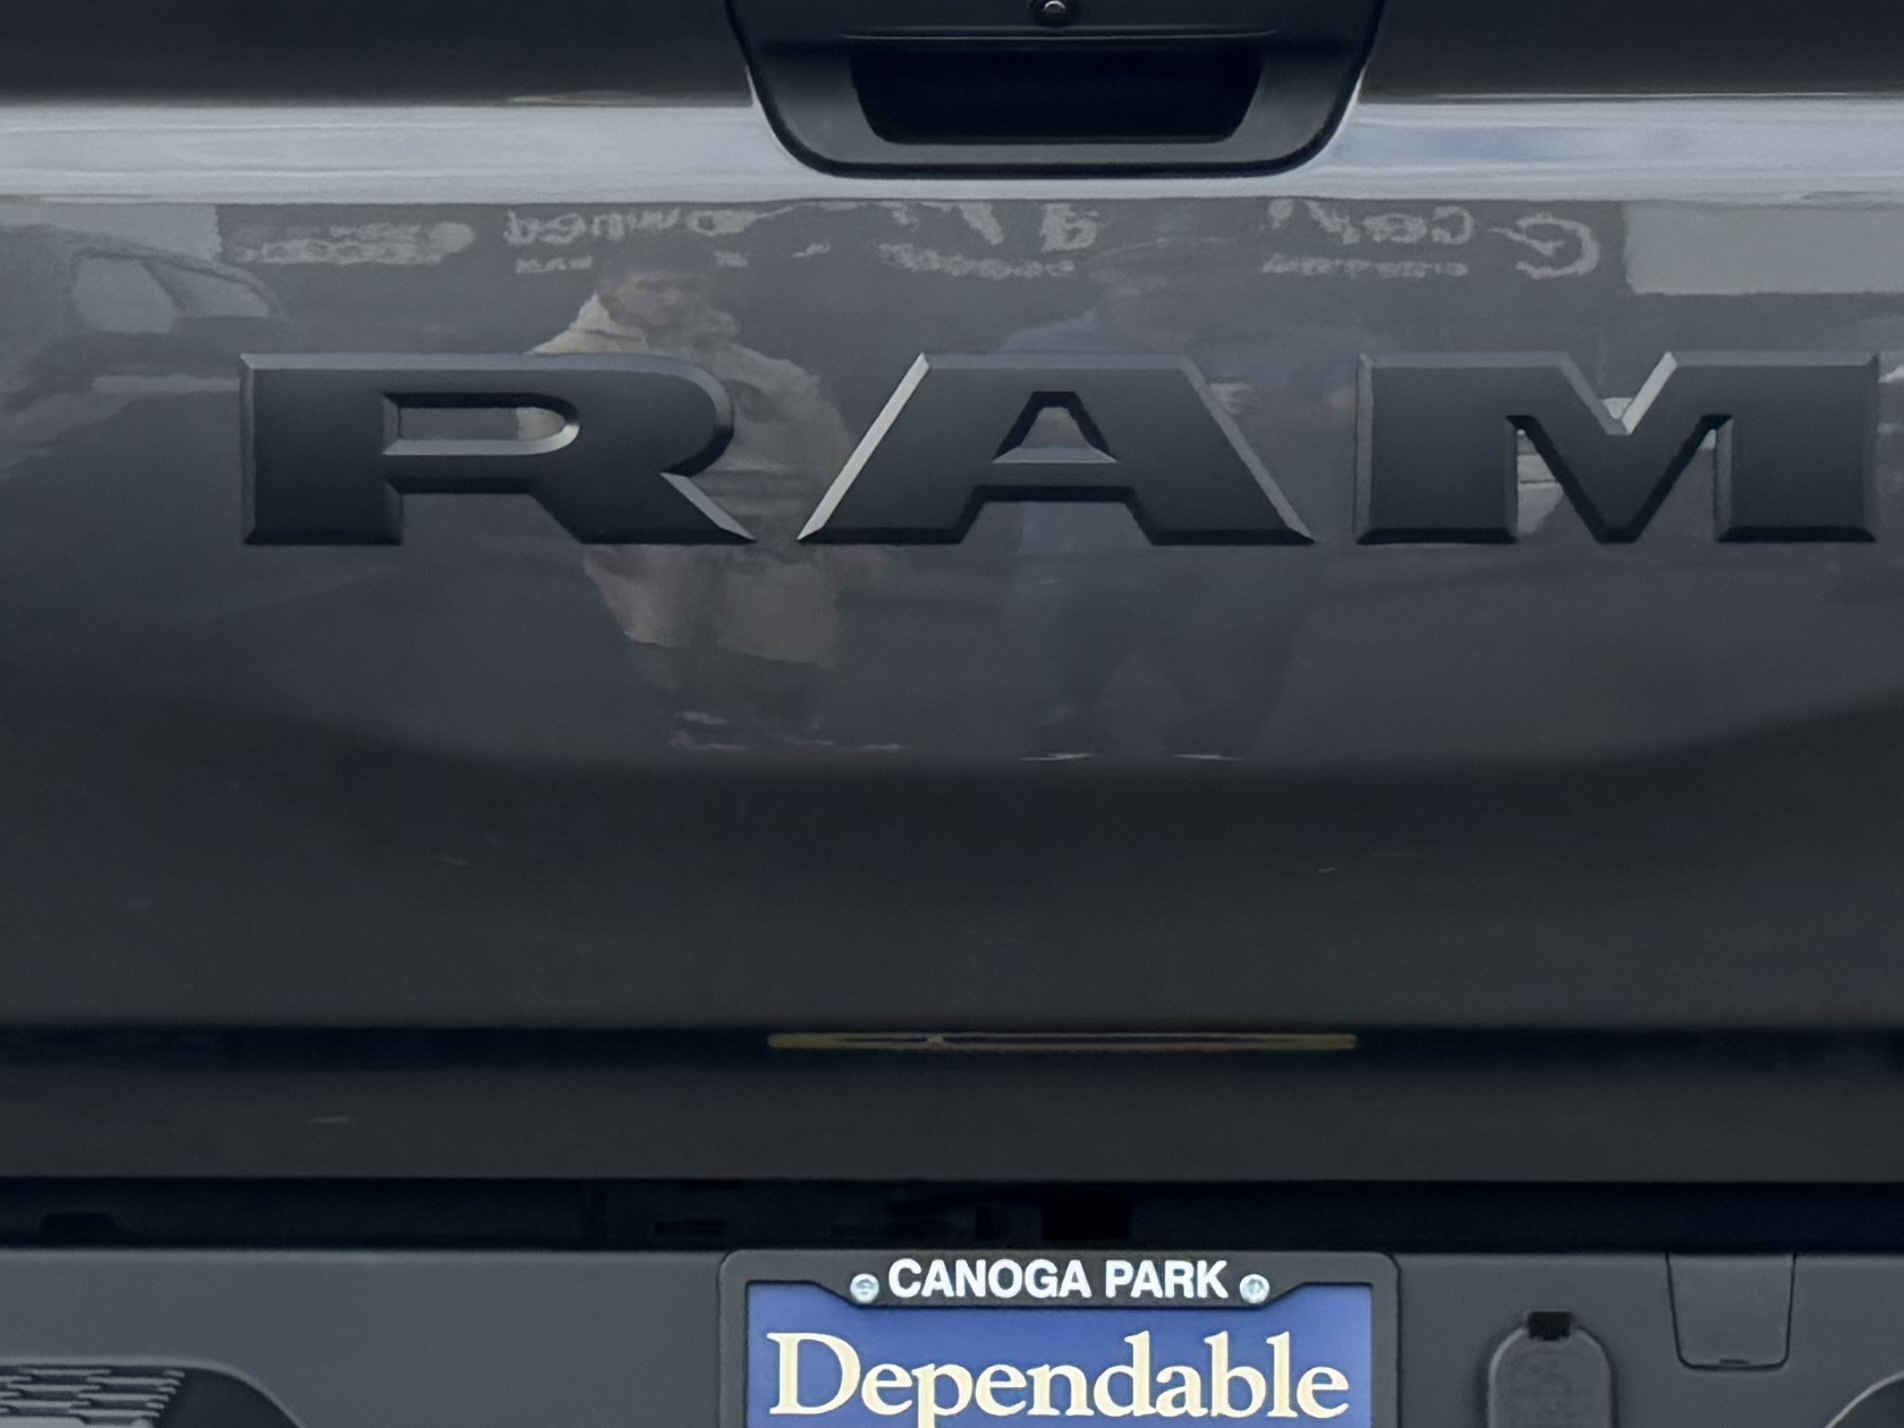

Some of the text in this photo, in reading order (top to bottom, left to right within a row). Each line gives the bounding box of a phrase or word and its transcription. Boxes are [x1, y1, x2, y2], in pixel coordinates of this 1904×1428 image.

[241, 351, 1880, 546] RAM
[888, 1258, 1229, 1300] CANOGA PARK
